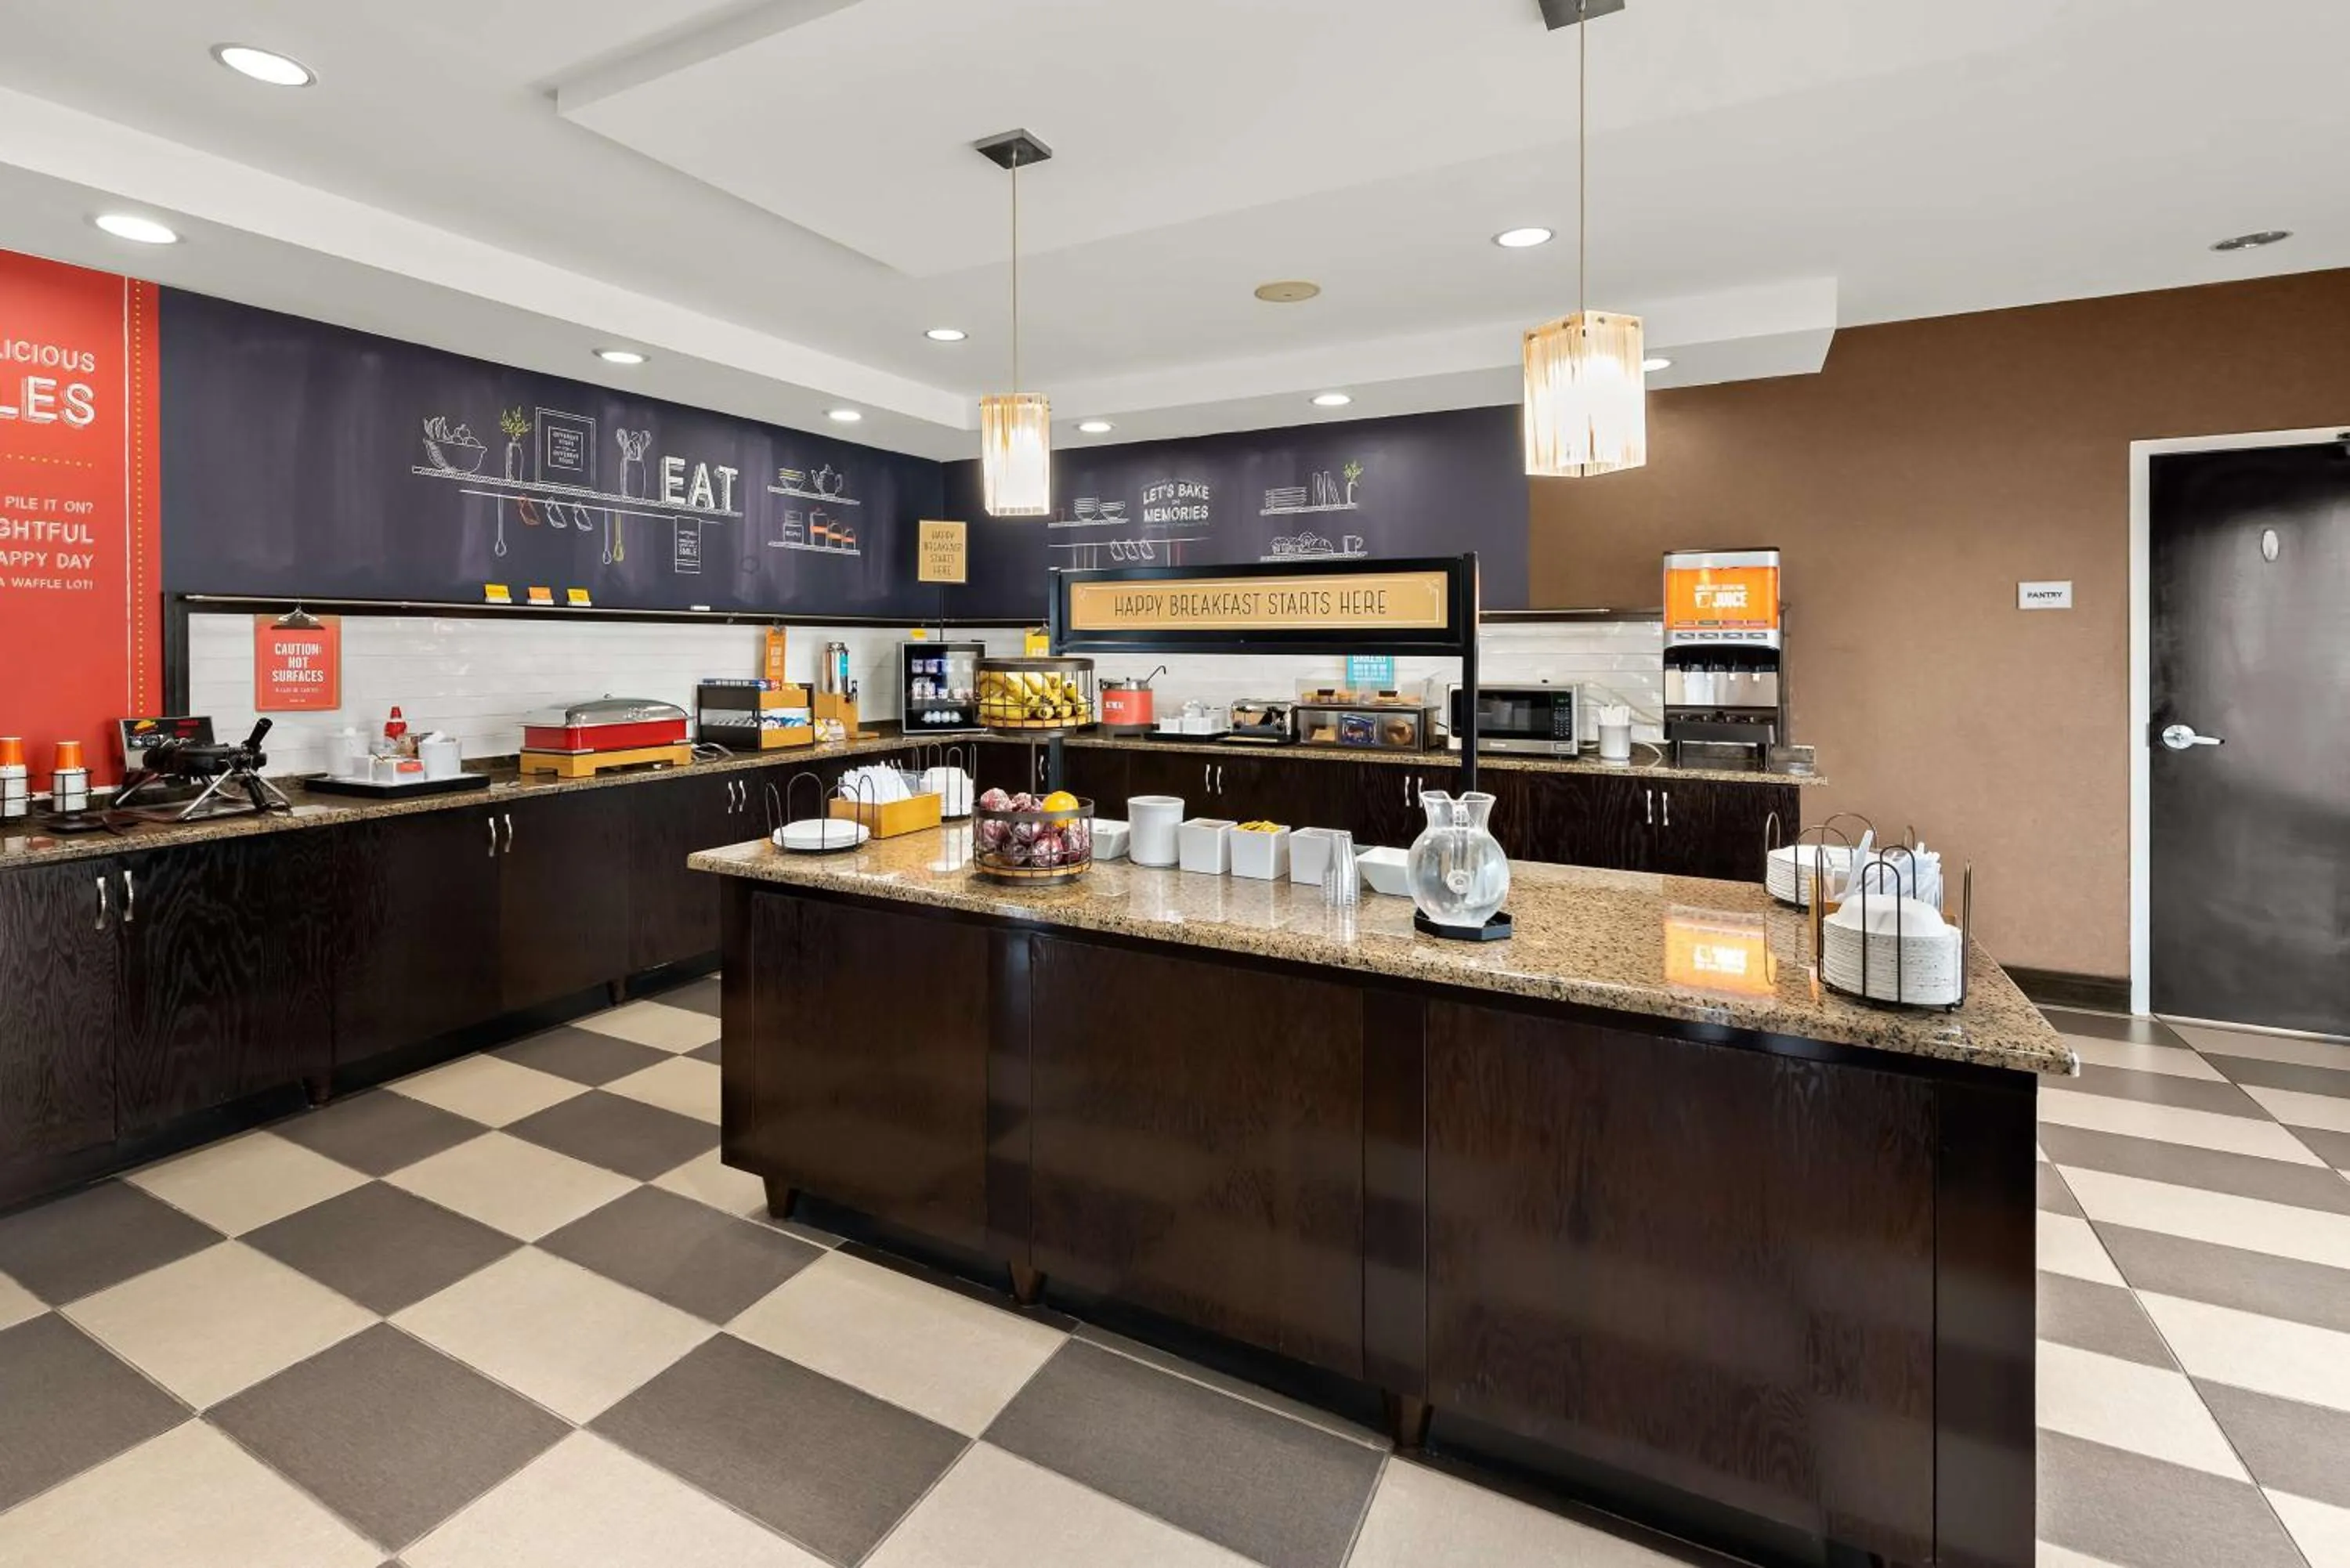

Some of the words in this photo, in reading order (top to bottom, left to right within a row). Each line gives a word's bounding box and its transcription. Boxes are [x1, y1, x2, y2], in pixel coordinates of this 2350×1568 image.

[0, 339, 96, 374] ICIOUS
[660, 456, 739, 511] EAT
[1143, 483, 1174, 505] LET'S
[1178, 483, 1209, 500] BAKE
[5, 495, 38, 511] PILE
[44, 499, 57, 512] IT
[63, 500, 94, 514] ON?
[1144, 505, 1209, 522] MEMORIES
[56, 553, 93, 570] DAY
[933, 565, 952, 576] HERE
[11, 576, 62, 589] WAFFLE
[1115, 594, 1163, 617] HAPPY
[1170, 593, 1261, 616] BREAKFAST
[1267, 591, 1331, 615] STARTS
[1340, 590, 1386, 615] HERE
[1712, 591, 1748, 608] JUICE
[2026, 591, 2063, 599] PANTRY
[275, 642, 322, 656] CAUTION:
[288, 656, 309, 668] HOT
[272, 670, 324, 682] SURFACES
